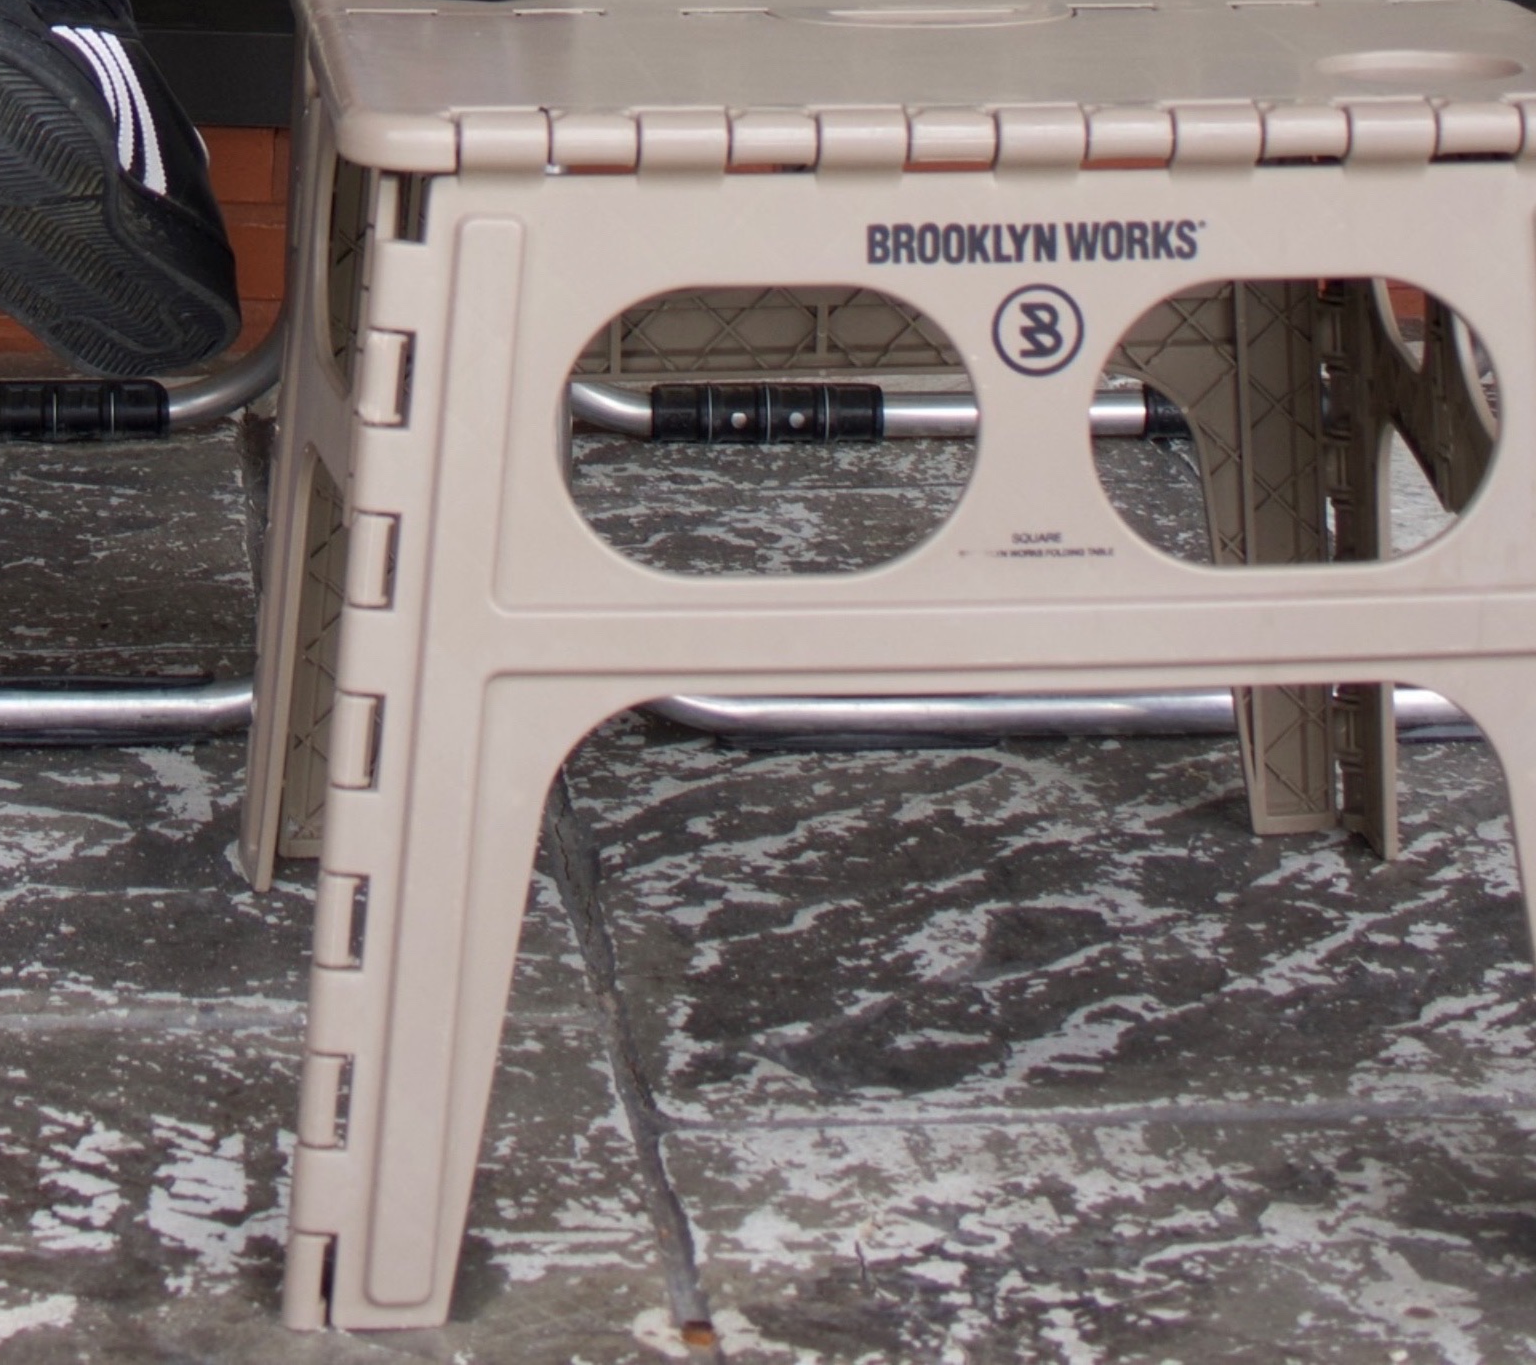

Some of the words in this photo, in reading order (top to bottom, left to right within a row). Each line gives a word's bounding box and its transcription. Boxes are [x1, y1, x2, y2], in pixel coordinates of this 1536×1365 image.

[866, 222, 1057, 265] BROOKLYN
[1064, 219, 1198, 262] WORKS
[1011, 533, 1062, 545] SQUARE
